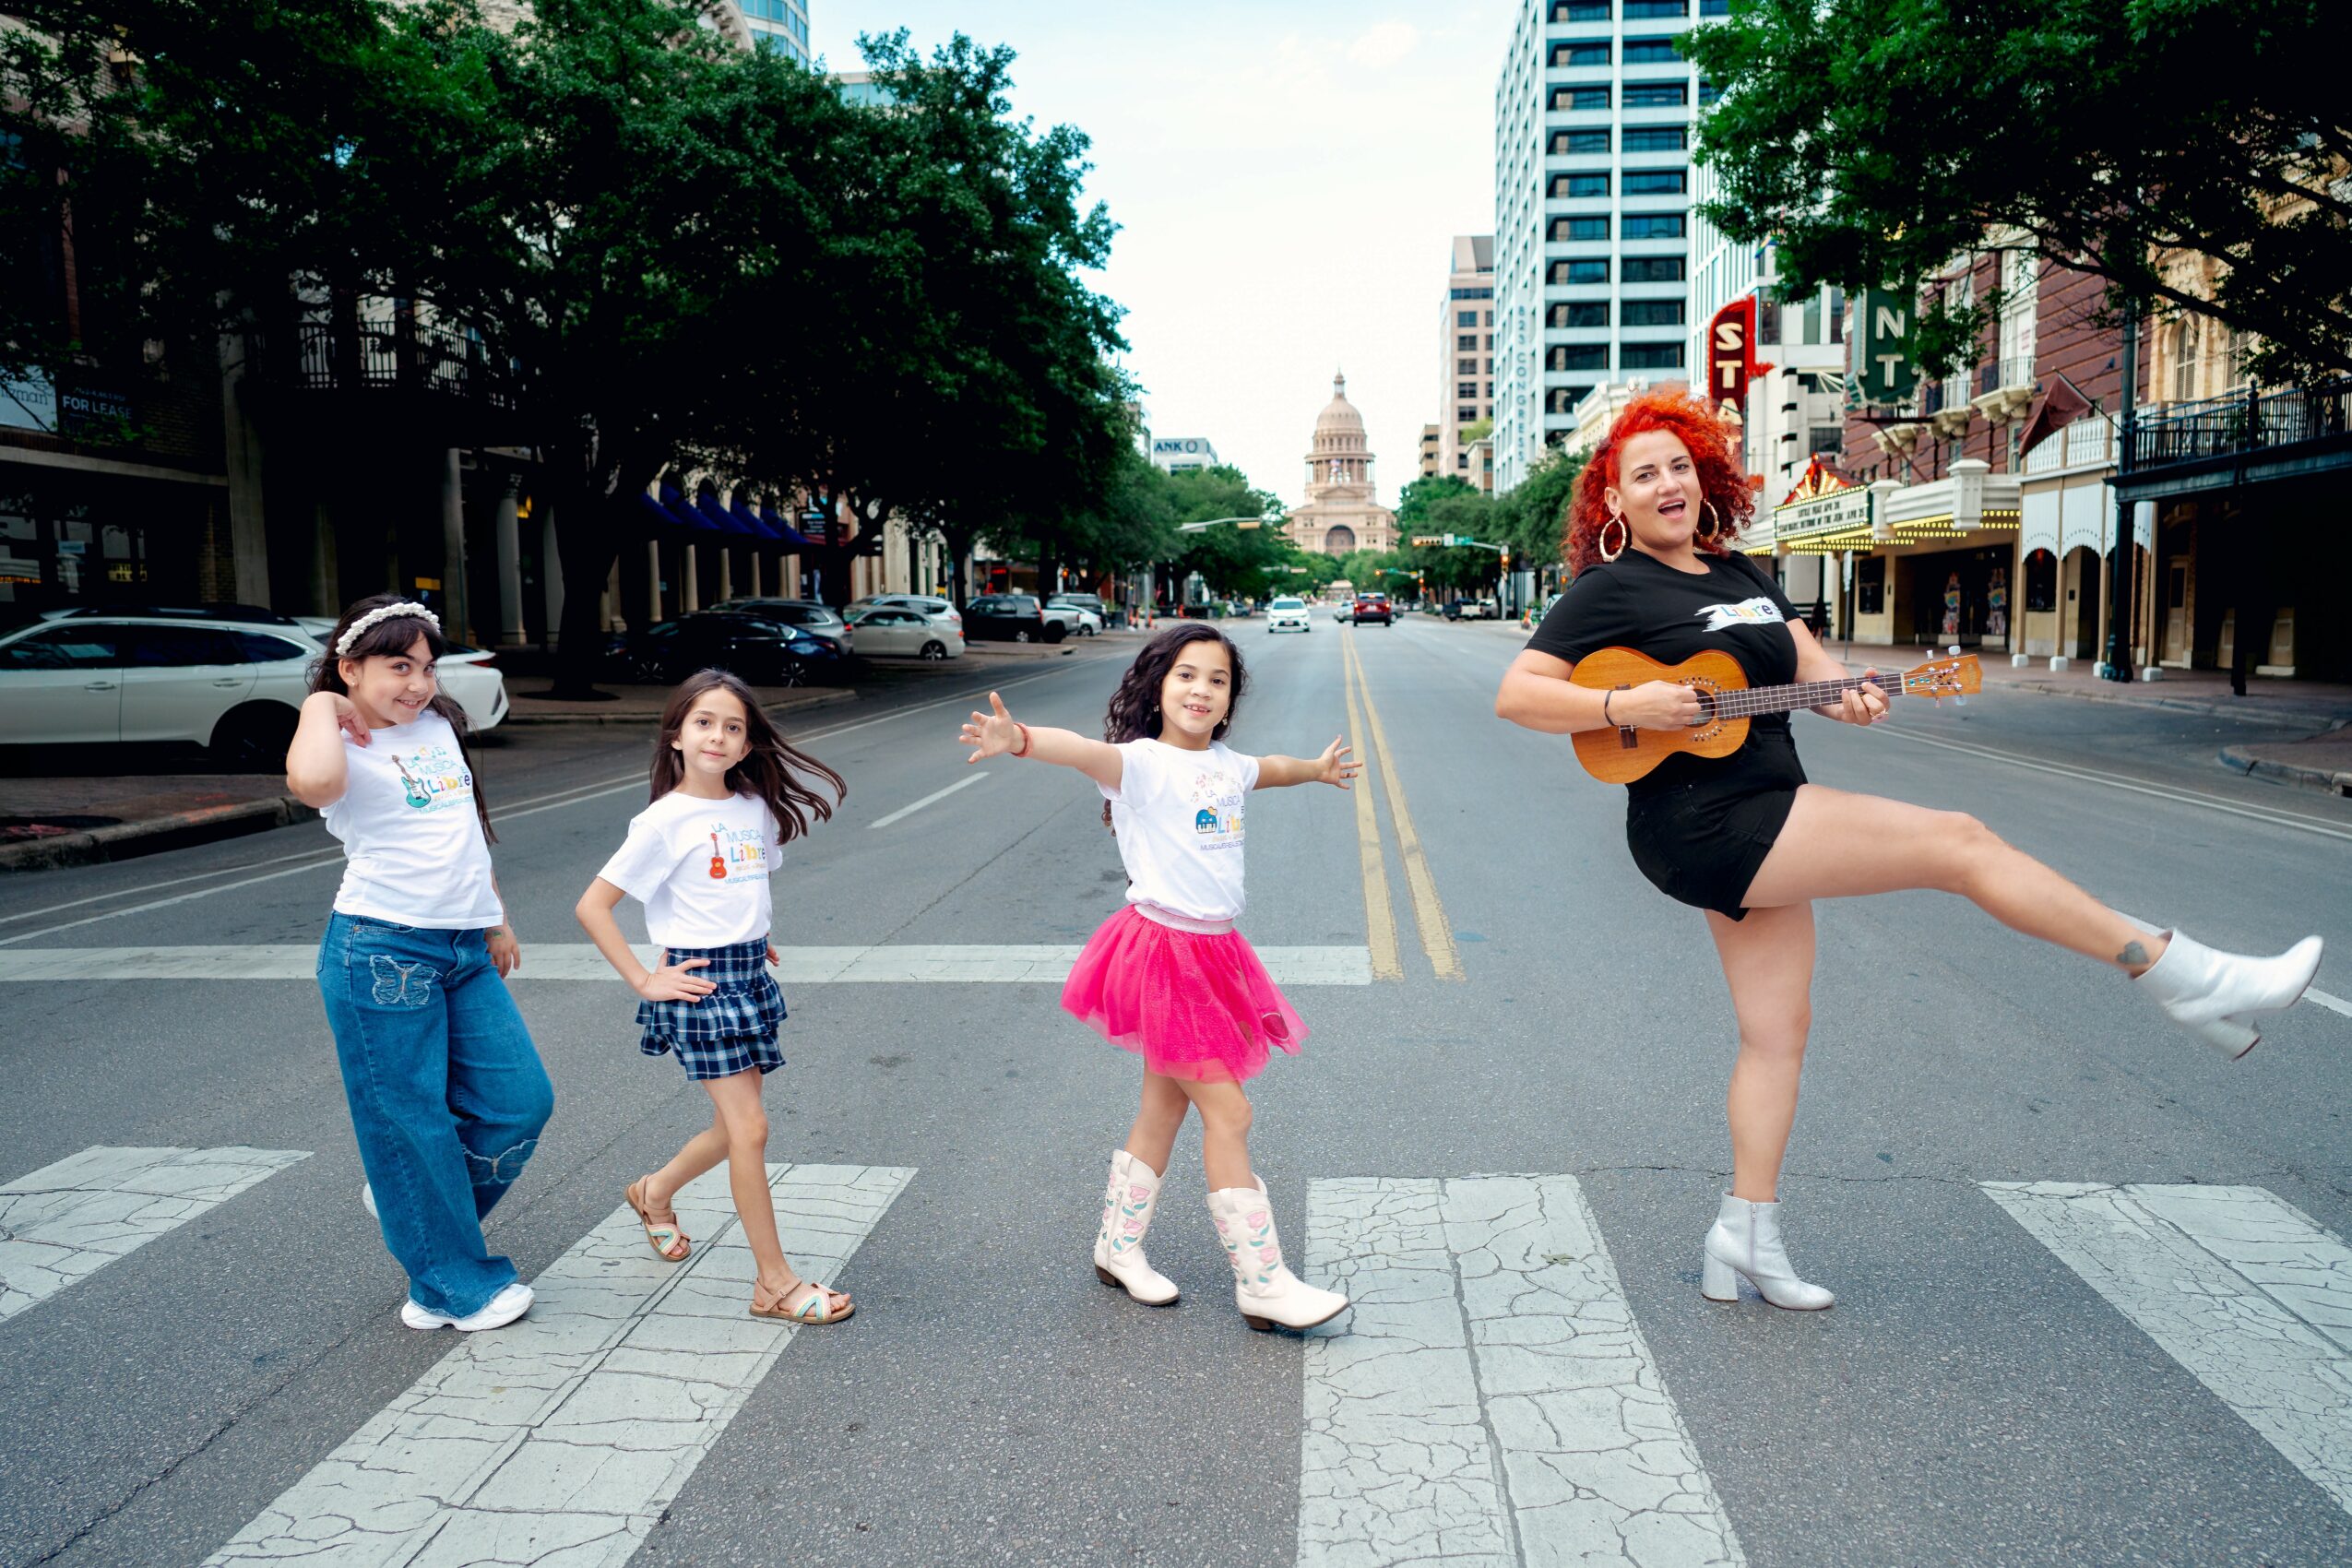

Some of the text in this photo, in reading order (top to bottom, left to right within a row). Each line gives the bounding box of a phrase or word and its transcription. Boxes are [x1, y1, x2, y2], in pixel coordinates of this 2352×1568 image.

[1516, 305, 1526, 461] 823 CONGRESS
[62, 396, 89, 411] FOR
[92, 401, 134, 419] LEASE
[427, 775, 470, 793] Libre
[711, 823, 728, 832] LA
[731, 843, 766, 862] Libre
